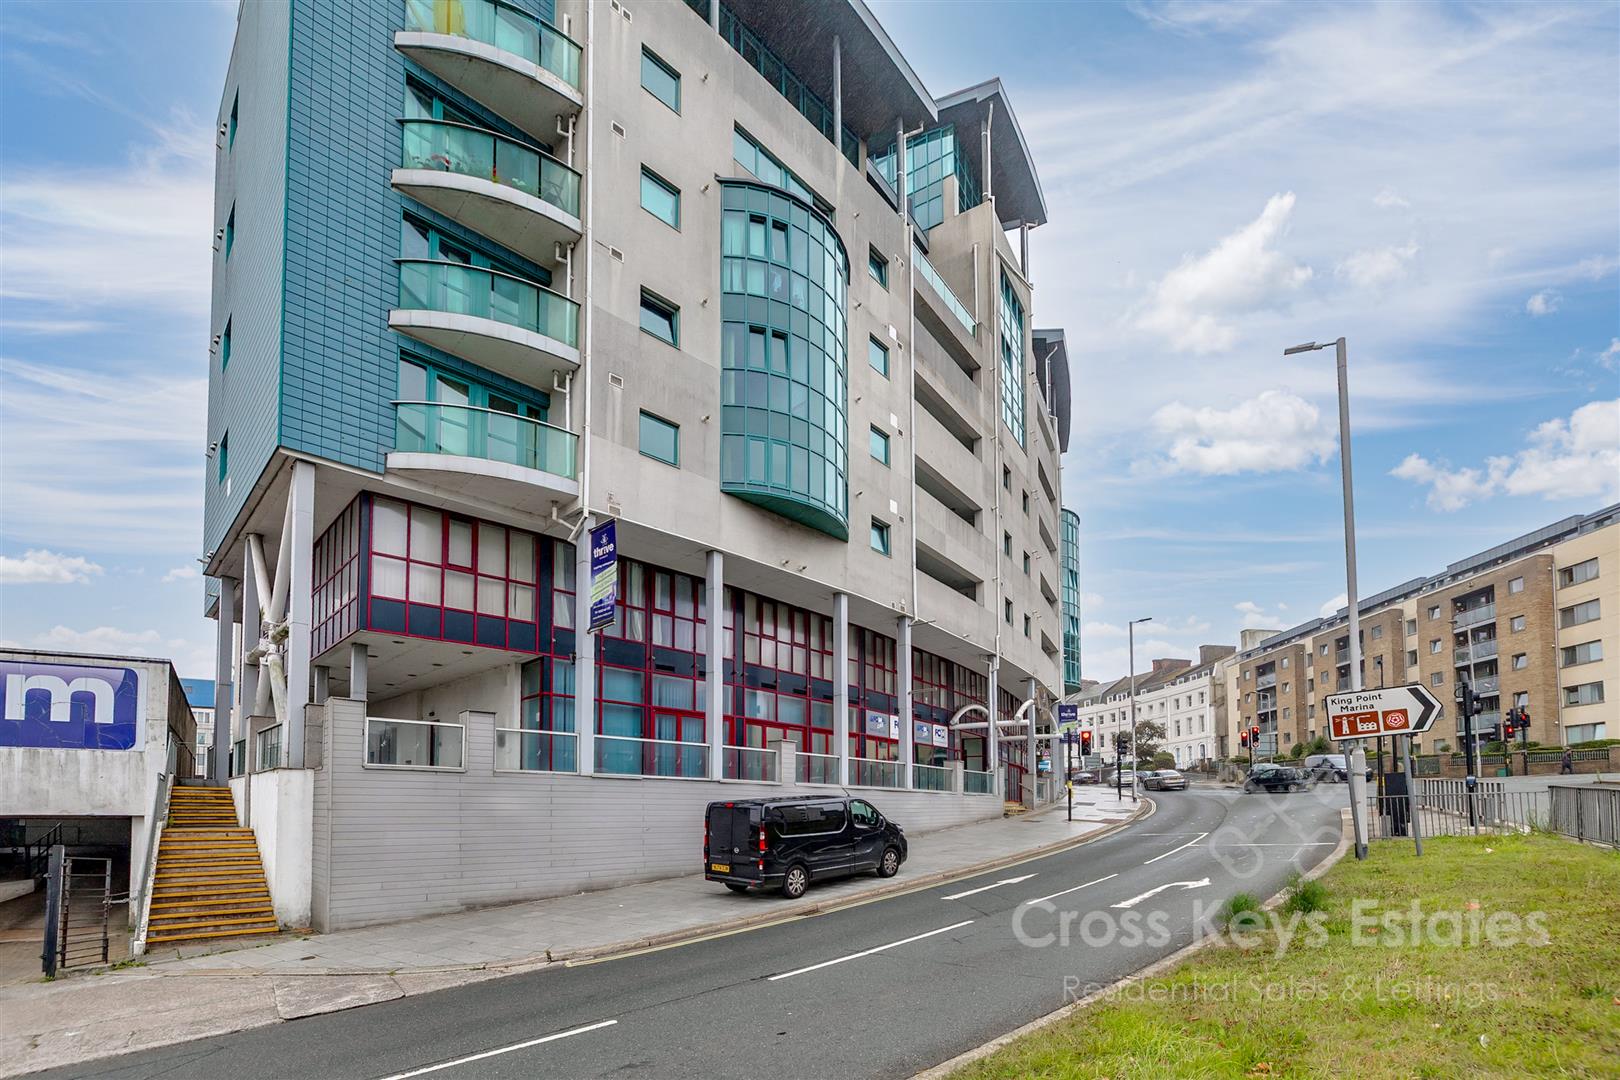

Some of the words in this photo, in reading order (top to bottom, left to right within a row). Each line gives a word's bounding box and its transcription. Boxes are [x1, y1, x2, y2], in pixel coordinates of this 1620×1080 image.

[593, 543, 614, 558] thrive
[1331, 697, 1352, 706] King
[1356, 693, 1382, 702] Point
[1340, 703, 1374, 712] Marina
